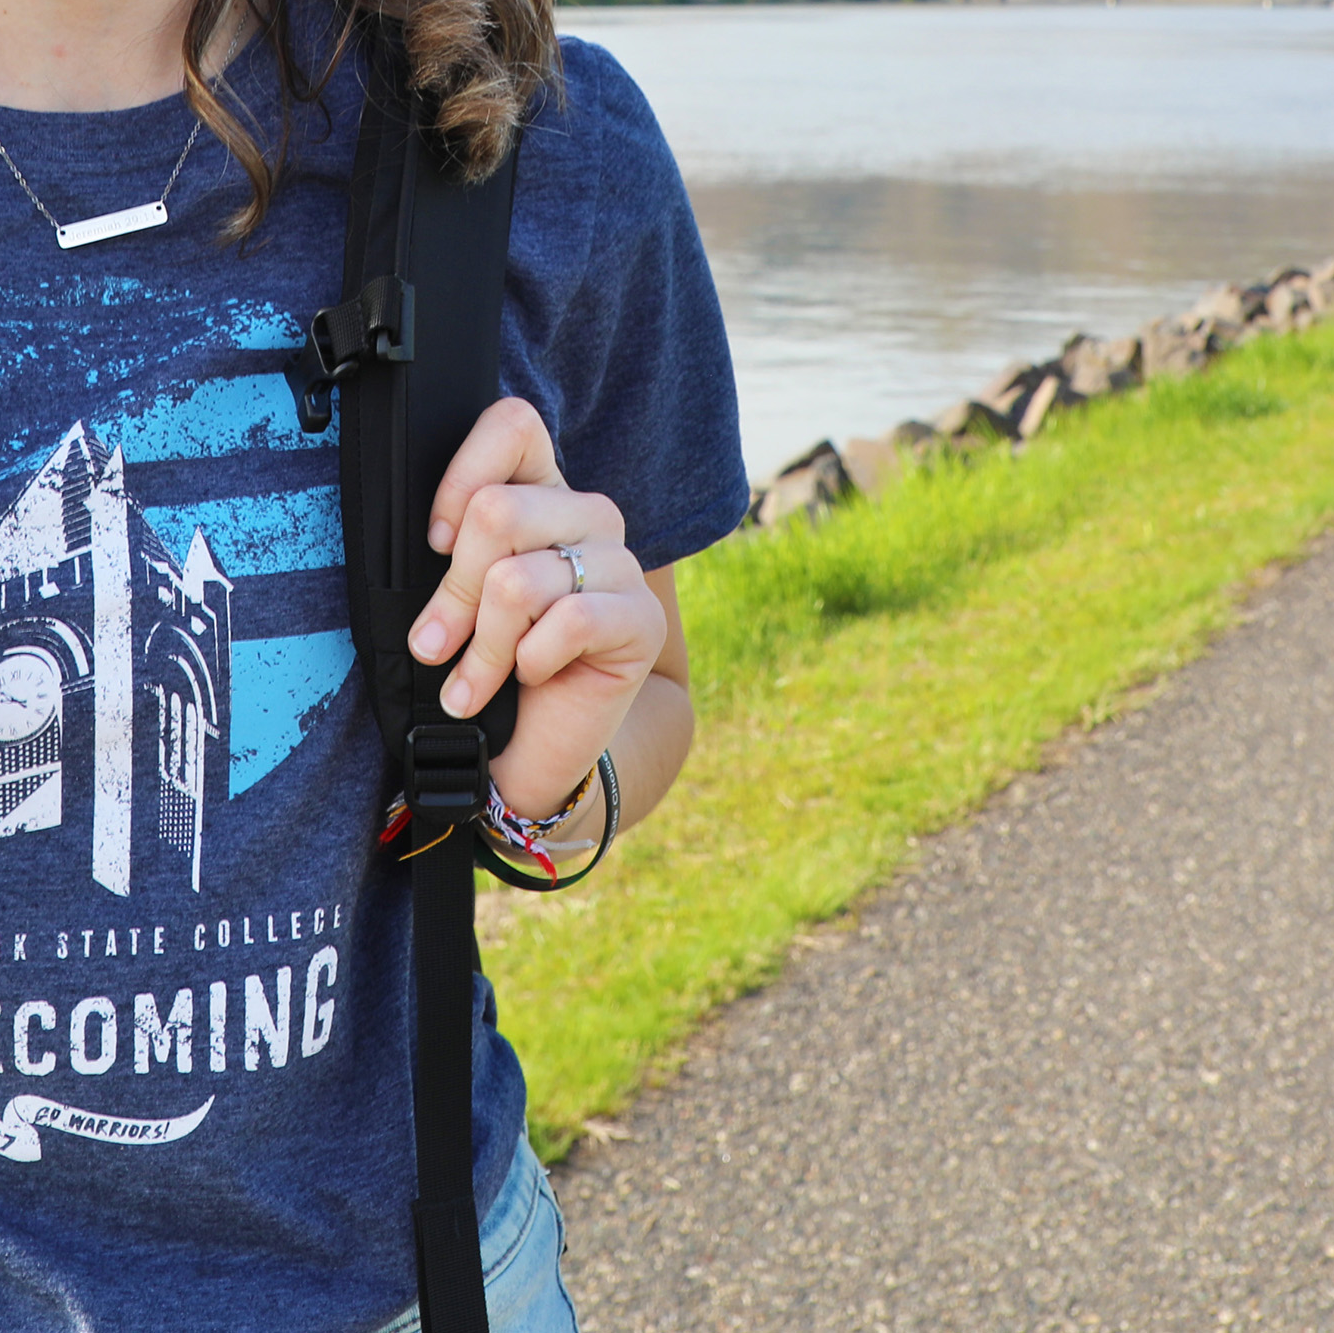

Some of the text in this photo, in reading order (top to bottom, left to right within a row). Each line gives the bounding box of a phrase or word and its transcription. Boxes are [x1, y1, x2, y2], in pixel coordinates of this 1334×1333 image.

[602, 752, 618, 806] Choice
[56, 926, 164, 959] STATE
[194, 904, 341, 951] COLLEGE
[34, 1106, 170, 1140] GO WARRIORS!
